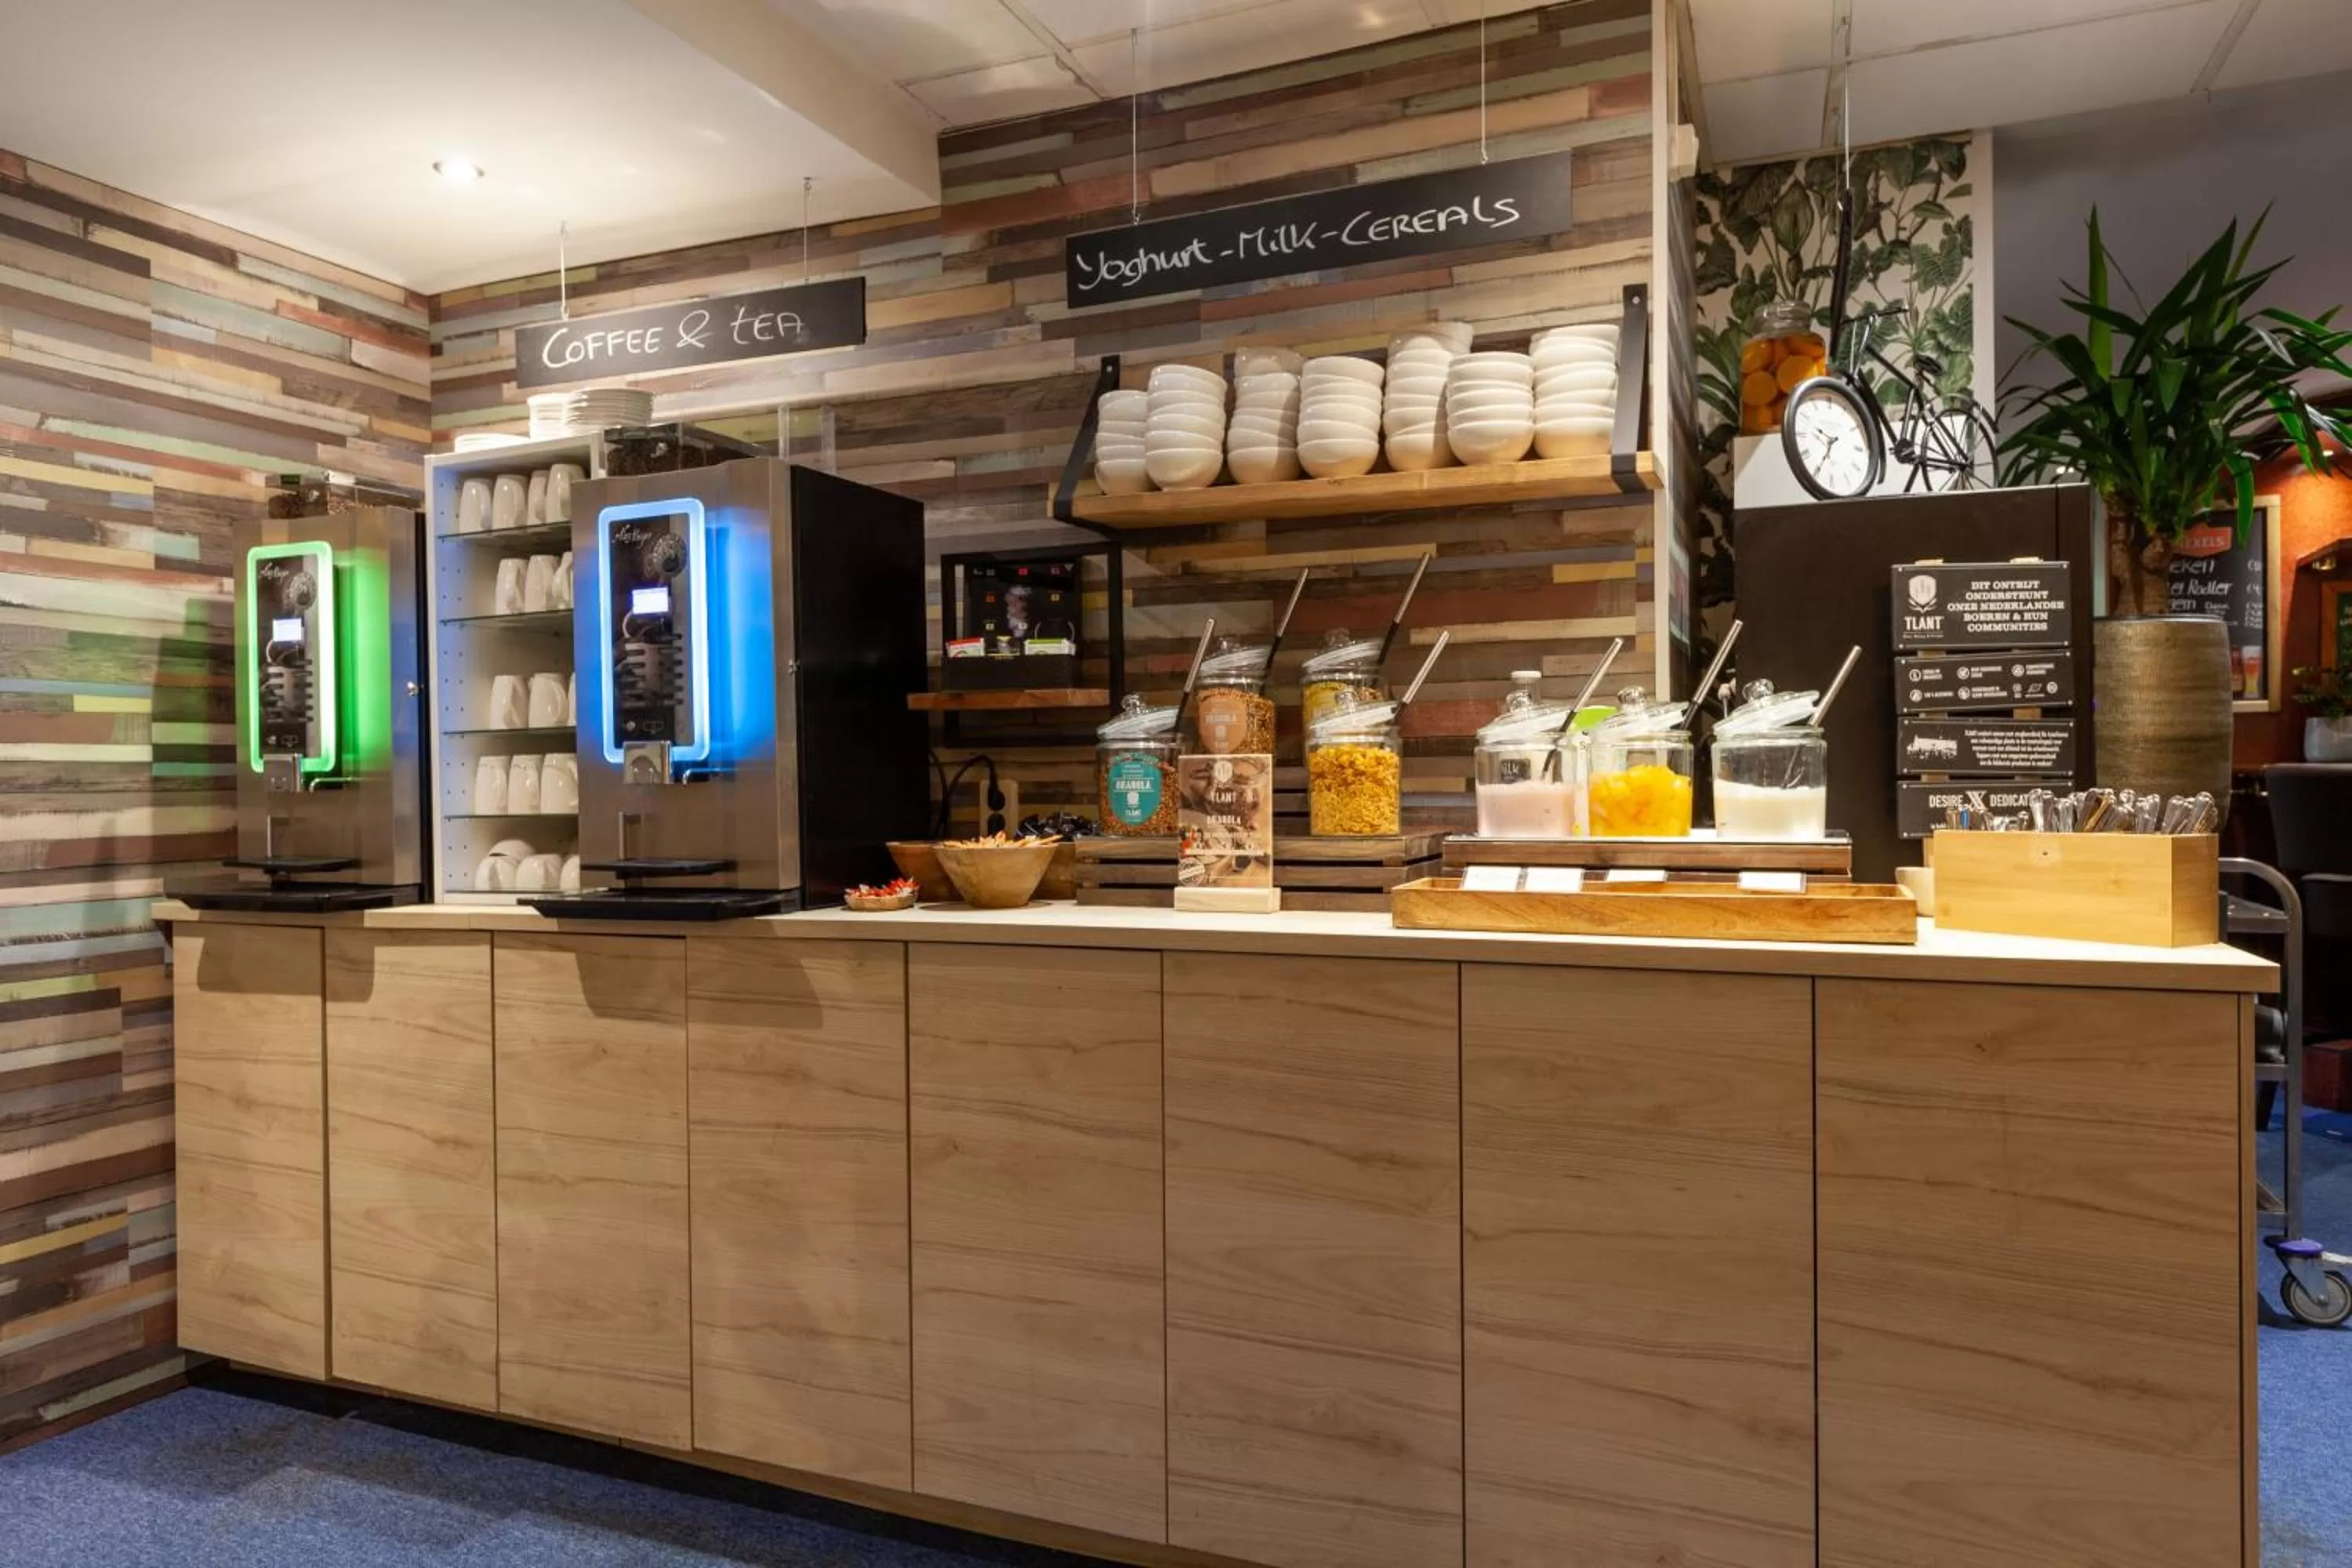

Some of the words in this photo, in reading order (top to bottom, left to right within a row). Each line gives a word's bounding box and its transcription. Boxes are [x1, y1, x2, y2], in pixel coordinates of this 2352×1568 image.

[677, 309, 714, 349] &
[1904, 615, 1944, 630] TLANT
[1967, 622, 2048, 632] COMMUNITIES
[1990, 793, 2031, 807] DEDICAT
